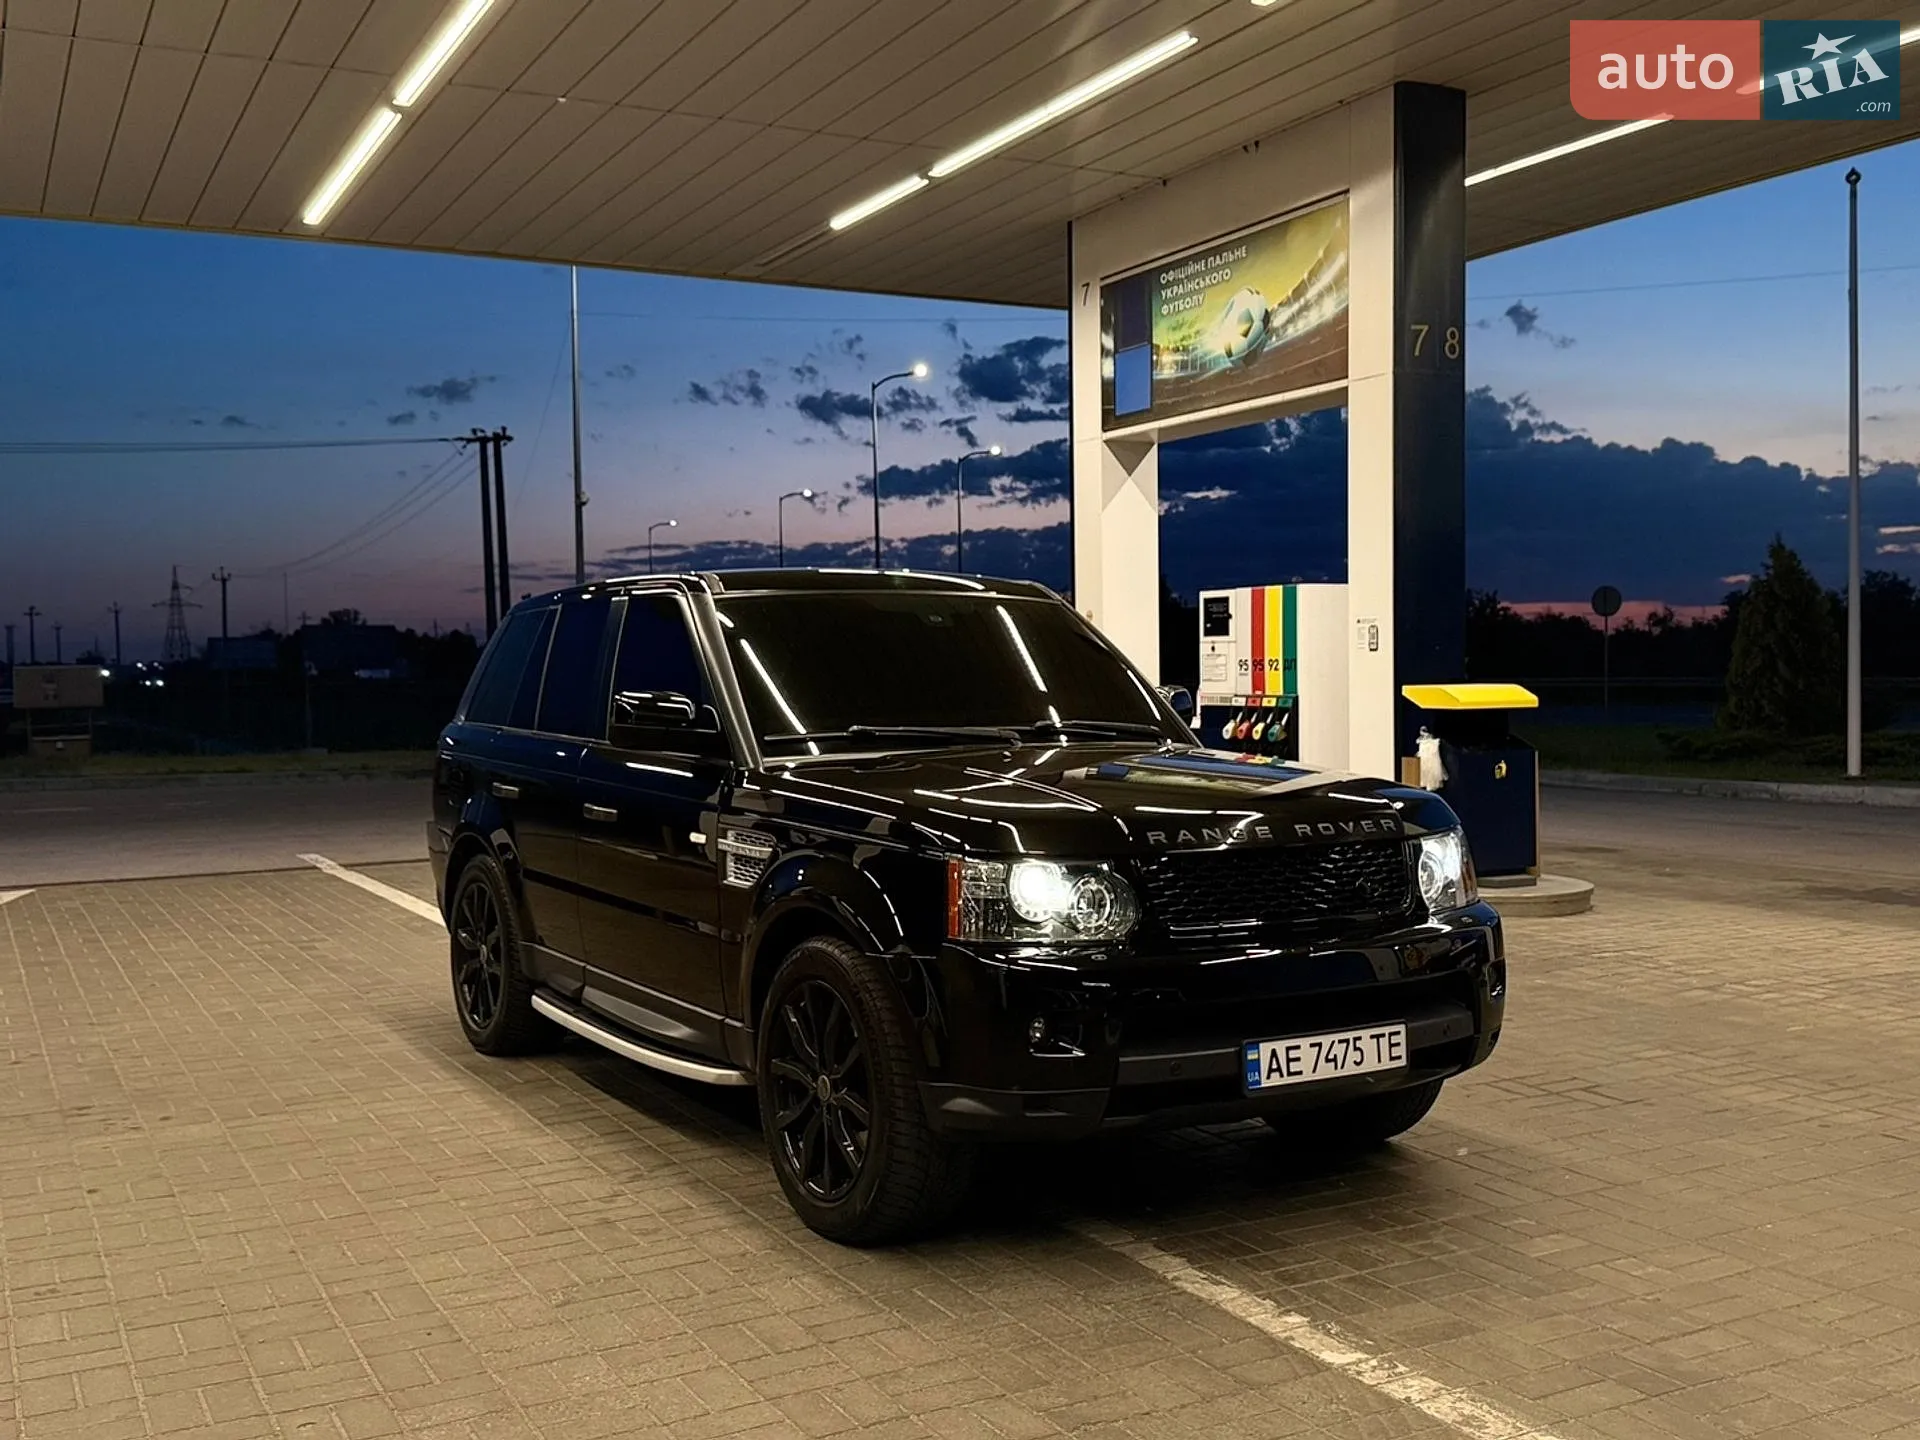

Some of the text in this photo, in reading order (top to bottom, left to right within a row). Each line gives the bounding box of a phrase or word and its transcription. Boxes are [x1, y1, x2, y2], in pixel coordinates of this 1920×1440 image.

[1159, 245, 1248, 285] ОФІЦІЙНЕ ПАЛЬНЕ
[1081, 282, 1090, 307] 7
[1160, 268, 1231, 299] УКРАЇНСЬКОГО
[1161, 294, 1206, 315] ФУТБОЛУ
[1410, 324, 1459, 359] 7 8
[1238, 658, 1249, 672] 95
[1268, 658, 1280, 672] 92
[1146, 818, 1397, 845] RANGE ROVER
[1266, 1030, 1403, 1080] AE 7475 TE
